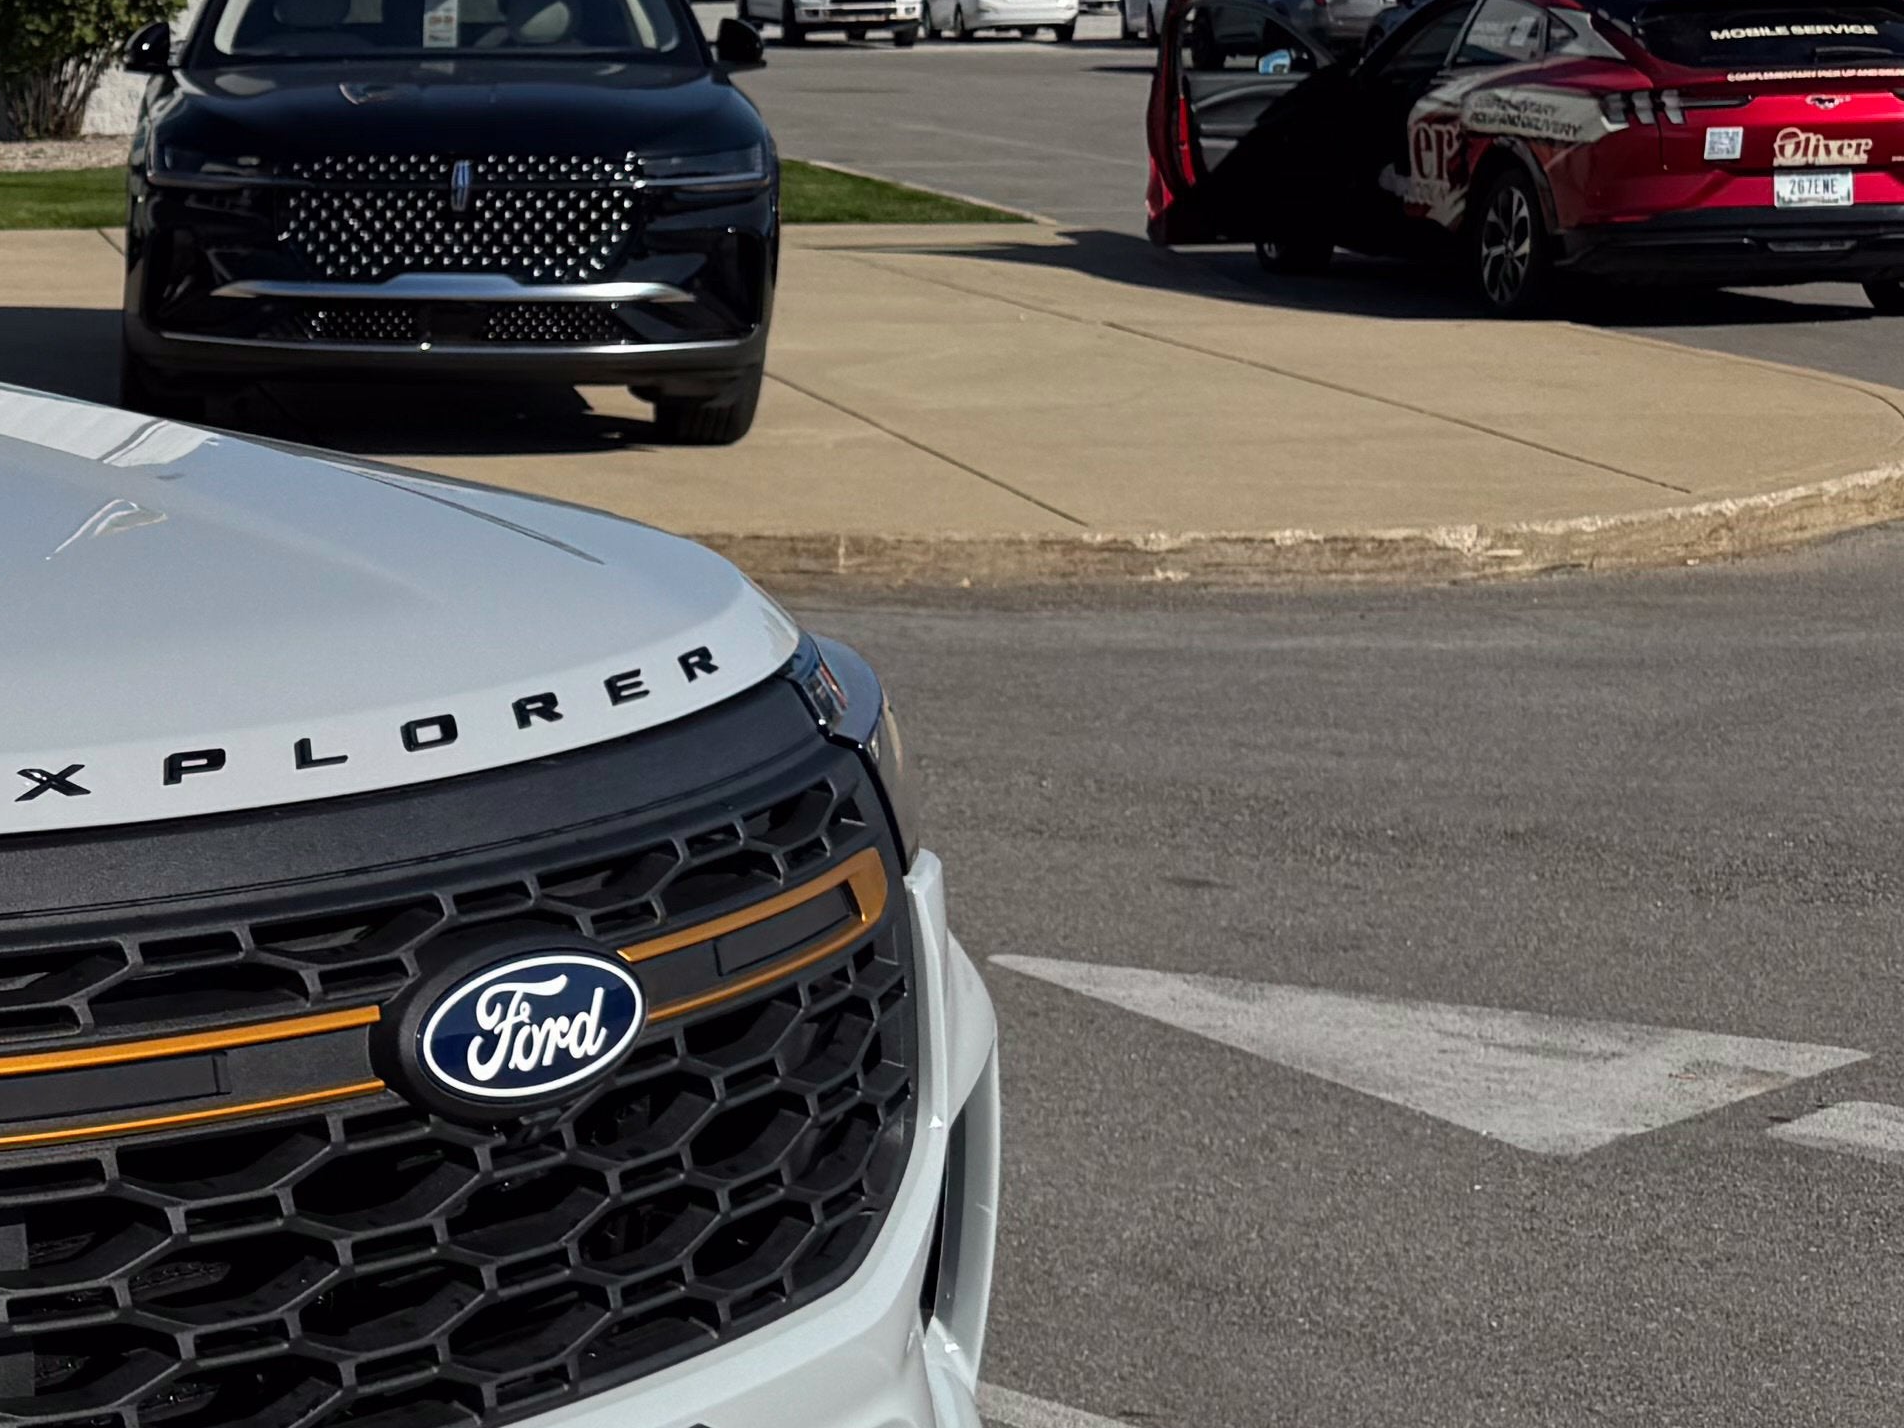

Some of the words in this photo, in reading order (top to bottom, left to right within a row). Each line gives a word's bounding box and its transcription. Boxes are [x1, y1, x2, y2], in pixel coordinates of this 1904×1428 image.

[1710, 25, 1790, 40] MOBILE
[1790, 24, 1879, 35] SERVICE
[1773, 127, 1873, 161] Oliver
[466, 972, 608, 1082] Ford
